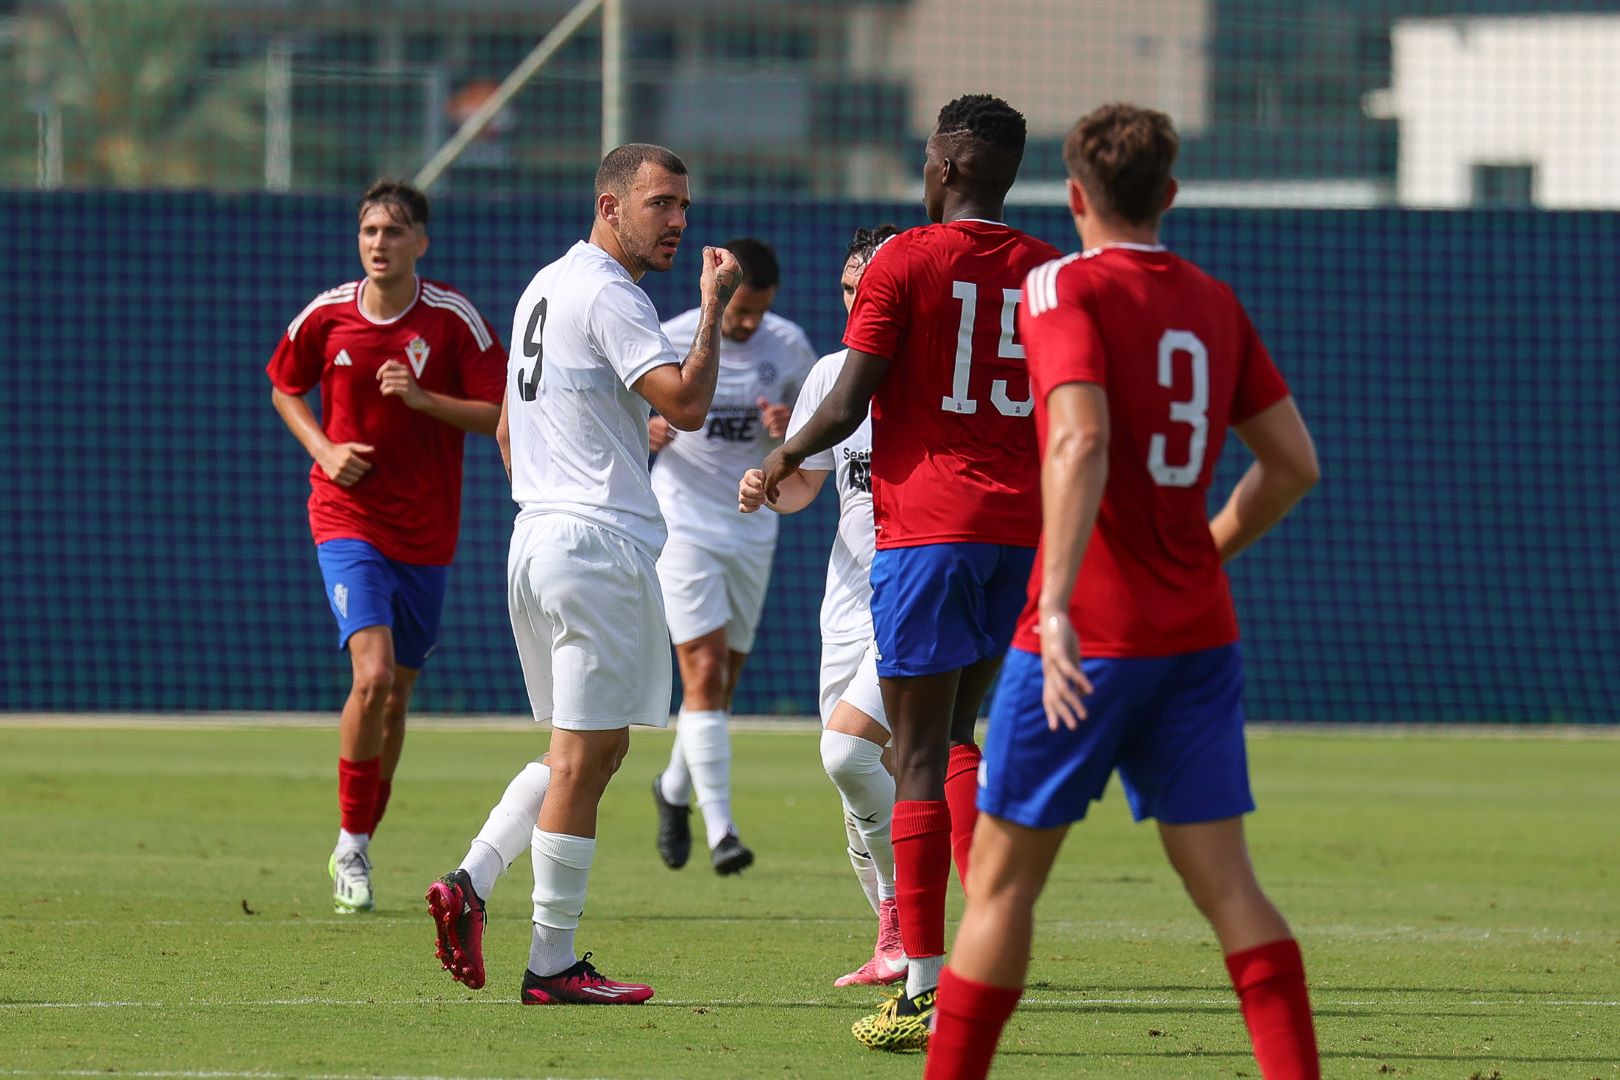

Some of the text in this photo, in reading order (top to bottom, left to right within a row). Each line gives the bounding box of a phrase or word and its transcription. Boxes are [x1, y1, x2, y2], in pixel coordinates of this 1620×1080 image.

[518, 297, 547, 401] 9
[942, 281, 1035, 416] 15
[1147, 329, 1209, 487] 3
[843, 447, 872, 460] Sesi
